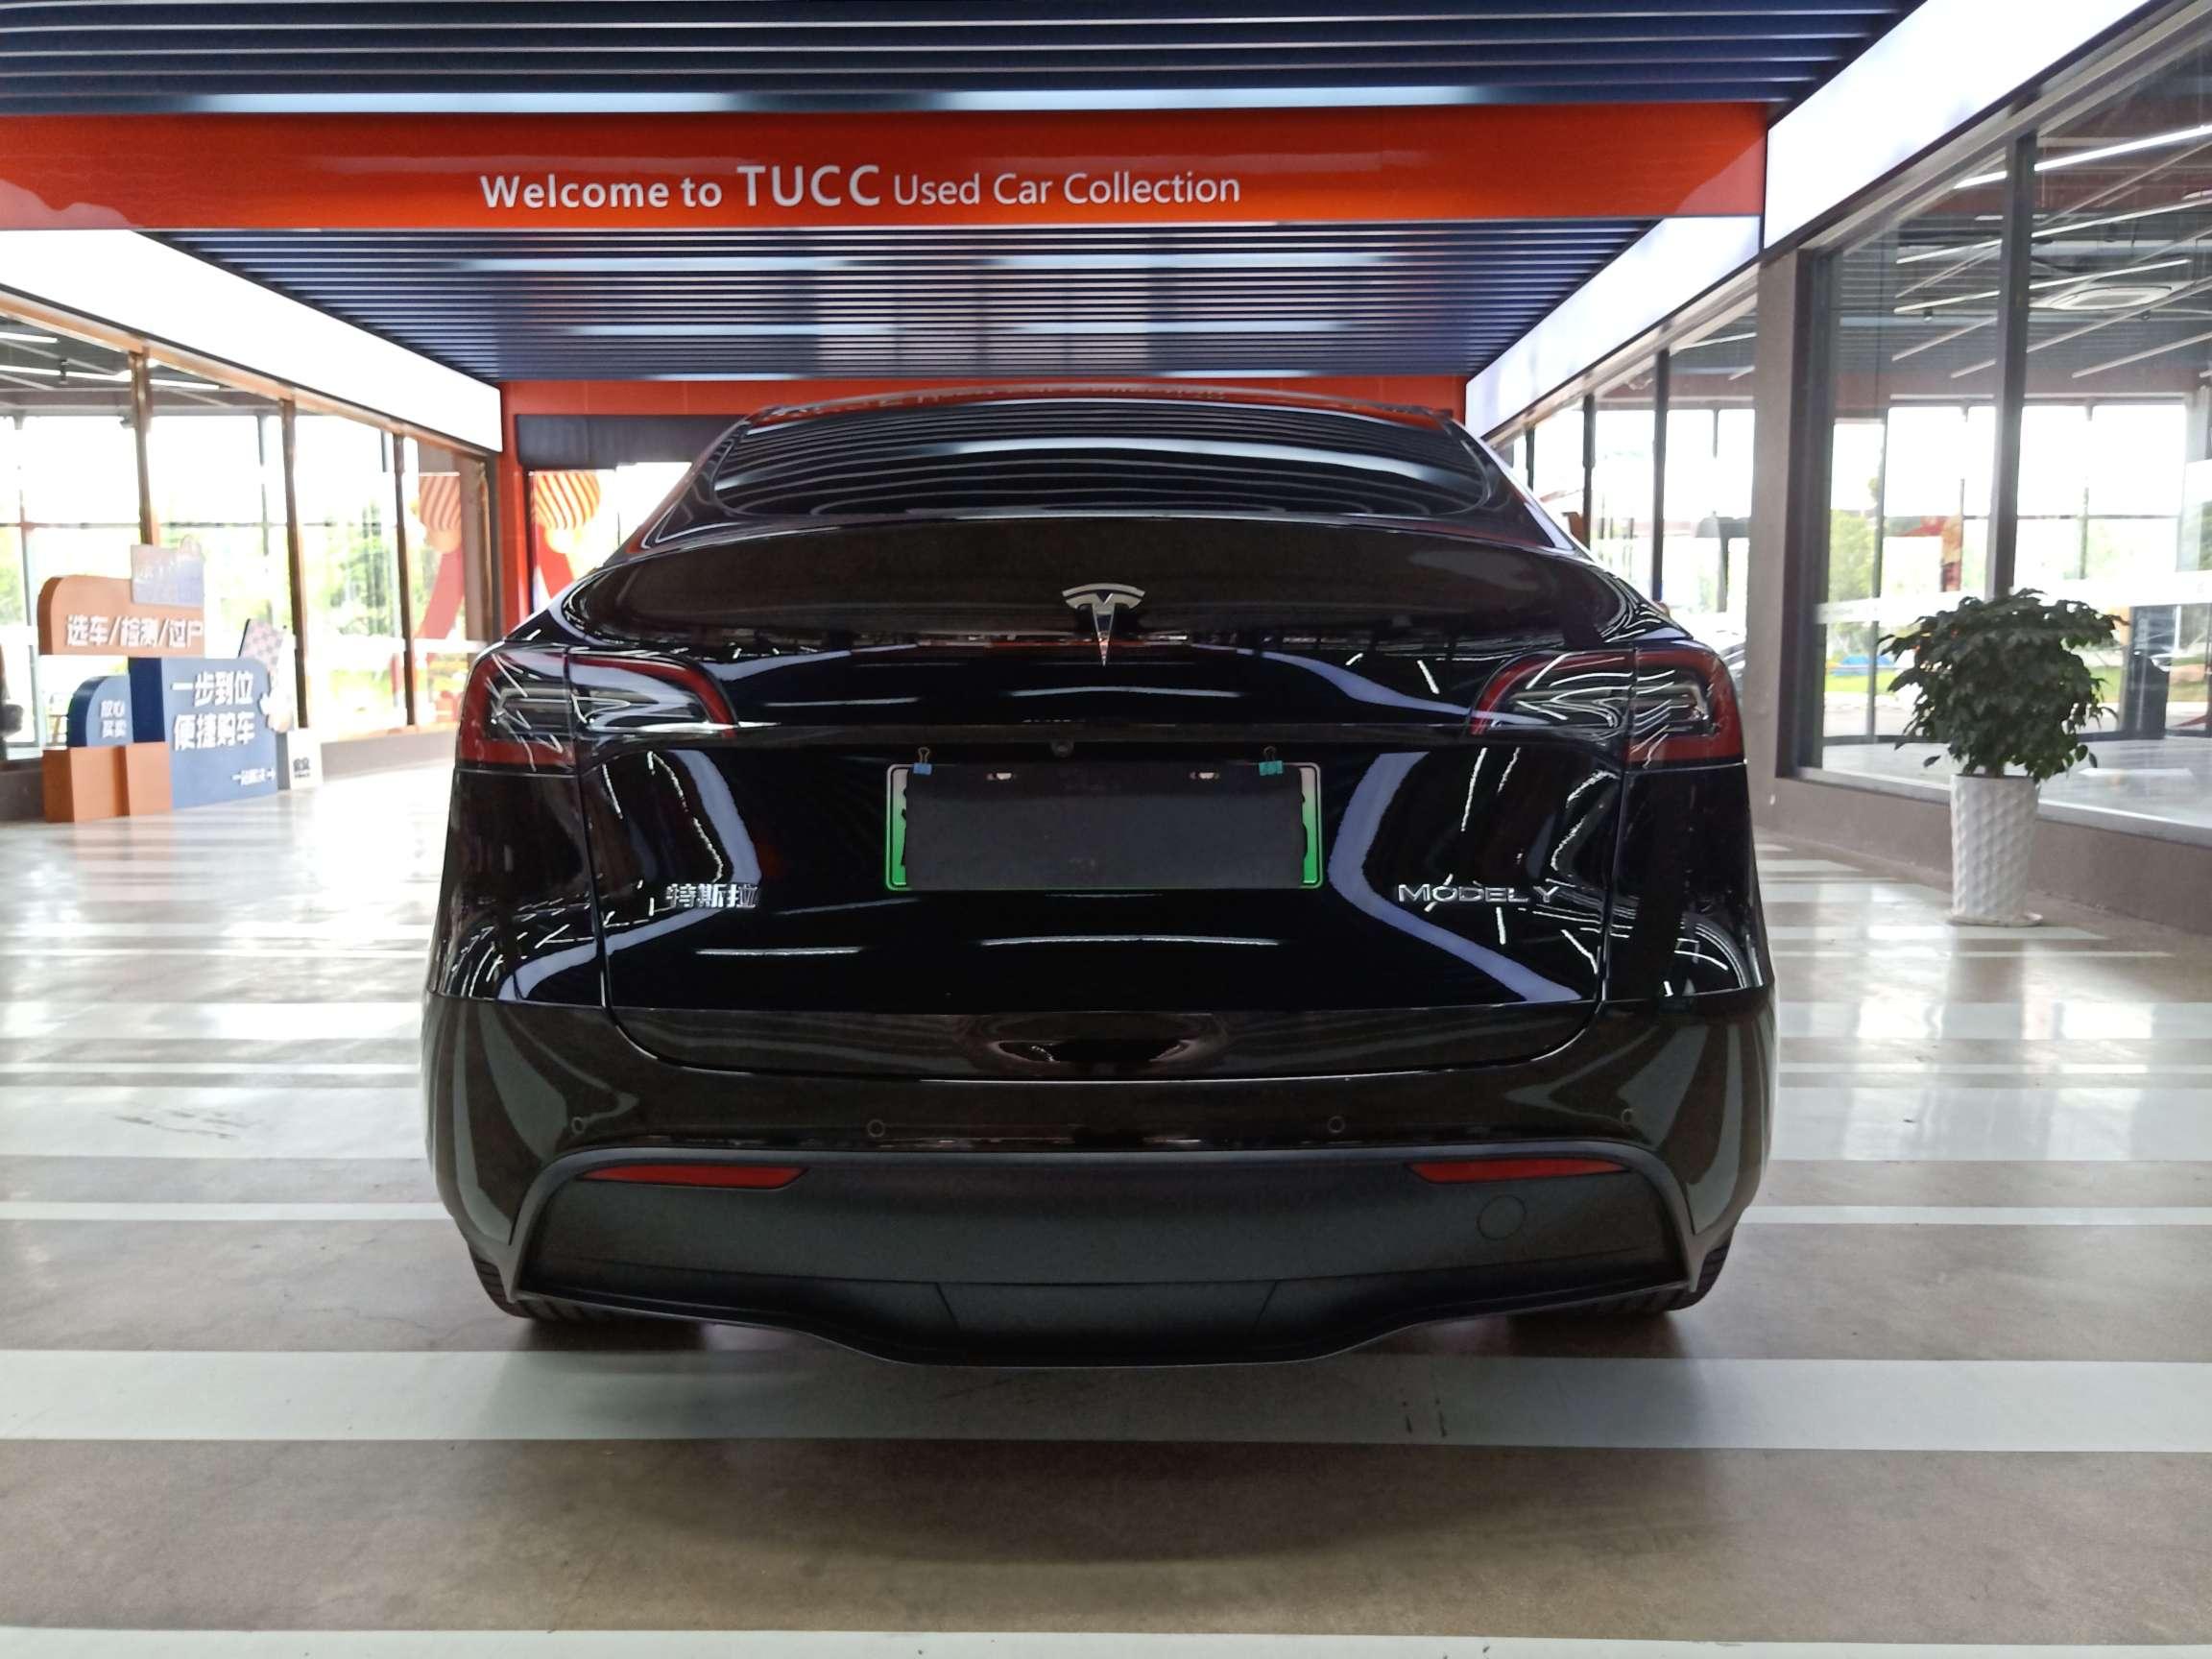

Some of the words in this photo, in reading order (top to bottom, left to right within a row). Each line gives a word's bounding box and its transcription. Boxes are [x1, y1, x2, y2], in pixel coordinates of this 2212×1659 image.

[479, 174, 670, 209] Welcome
[680, 178, 723, 208] to
[736, 165, 880, 207] TUCC
[894, 173, 979, 206] Used
[994, 173, 1052, 205] Car
[1064, 171, 1241, 204] Collection
[171, 670, 253, 707] 一步到位
[174, 711, 255, 752] 便捷购车
[665, 882, 758, 908] 特斯拉
[1398, 883, 1529, 902] MODEL
[1533, 884, 1560, 903] Y
